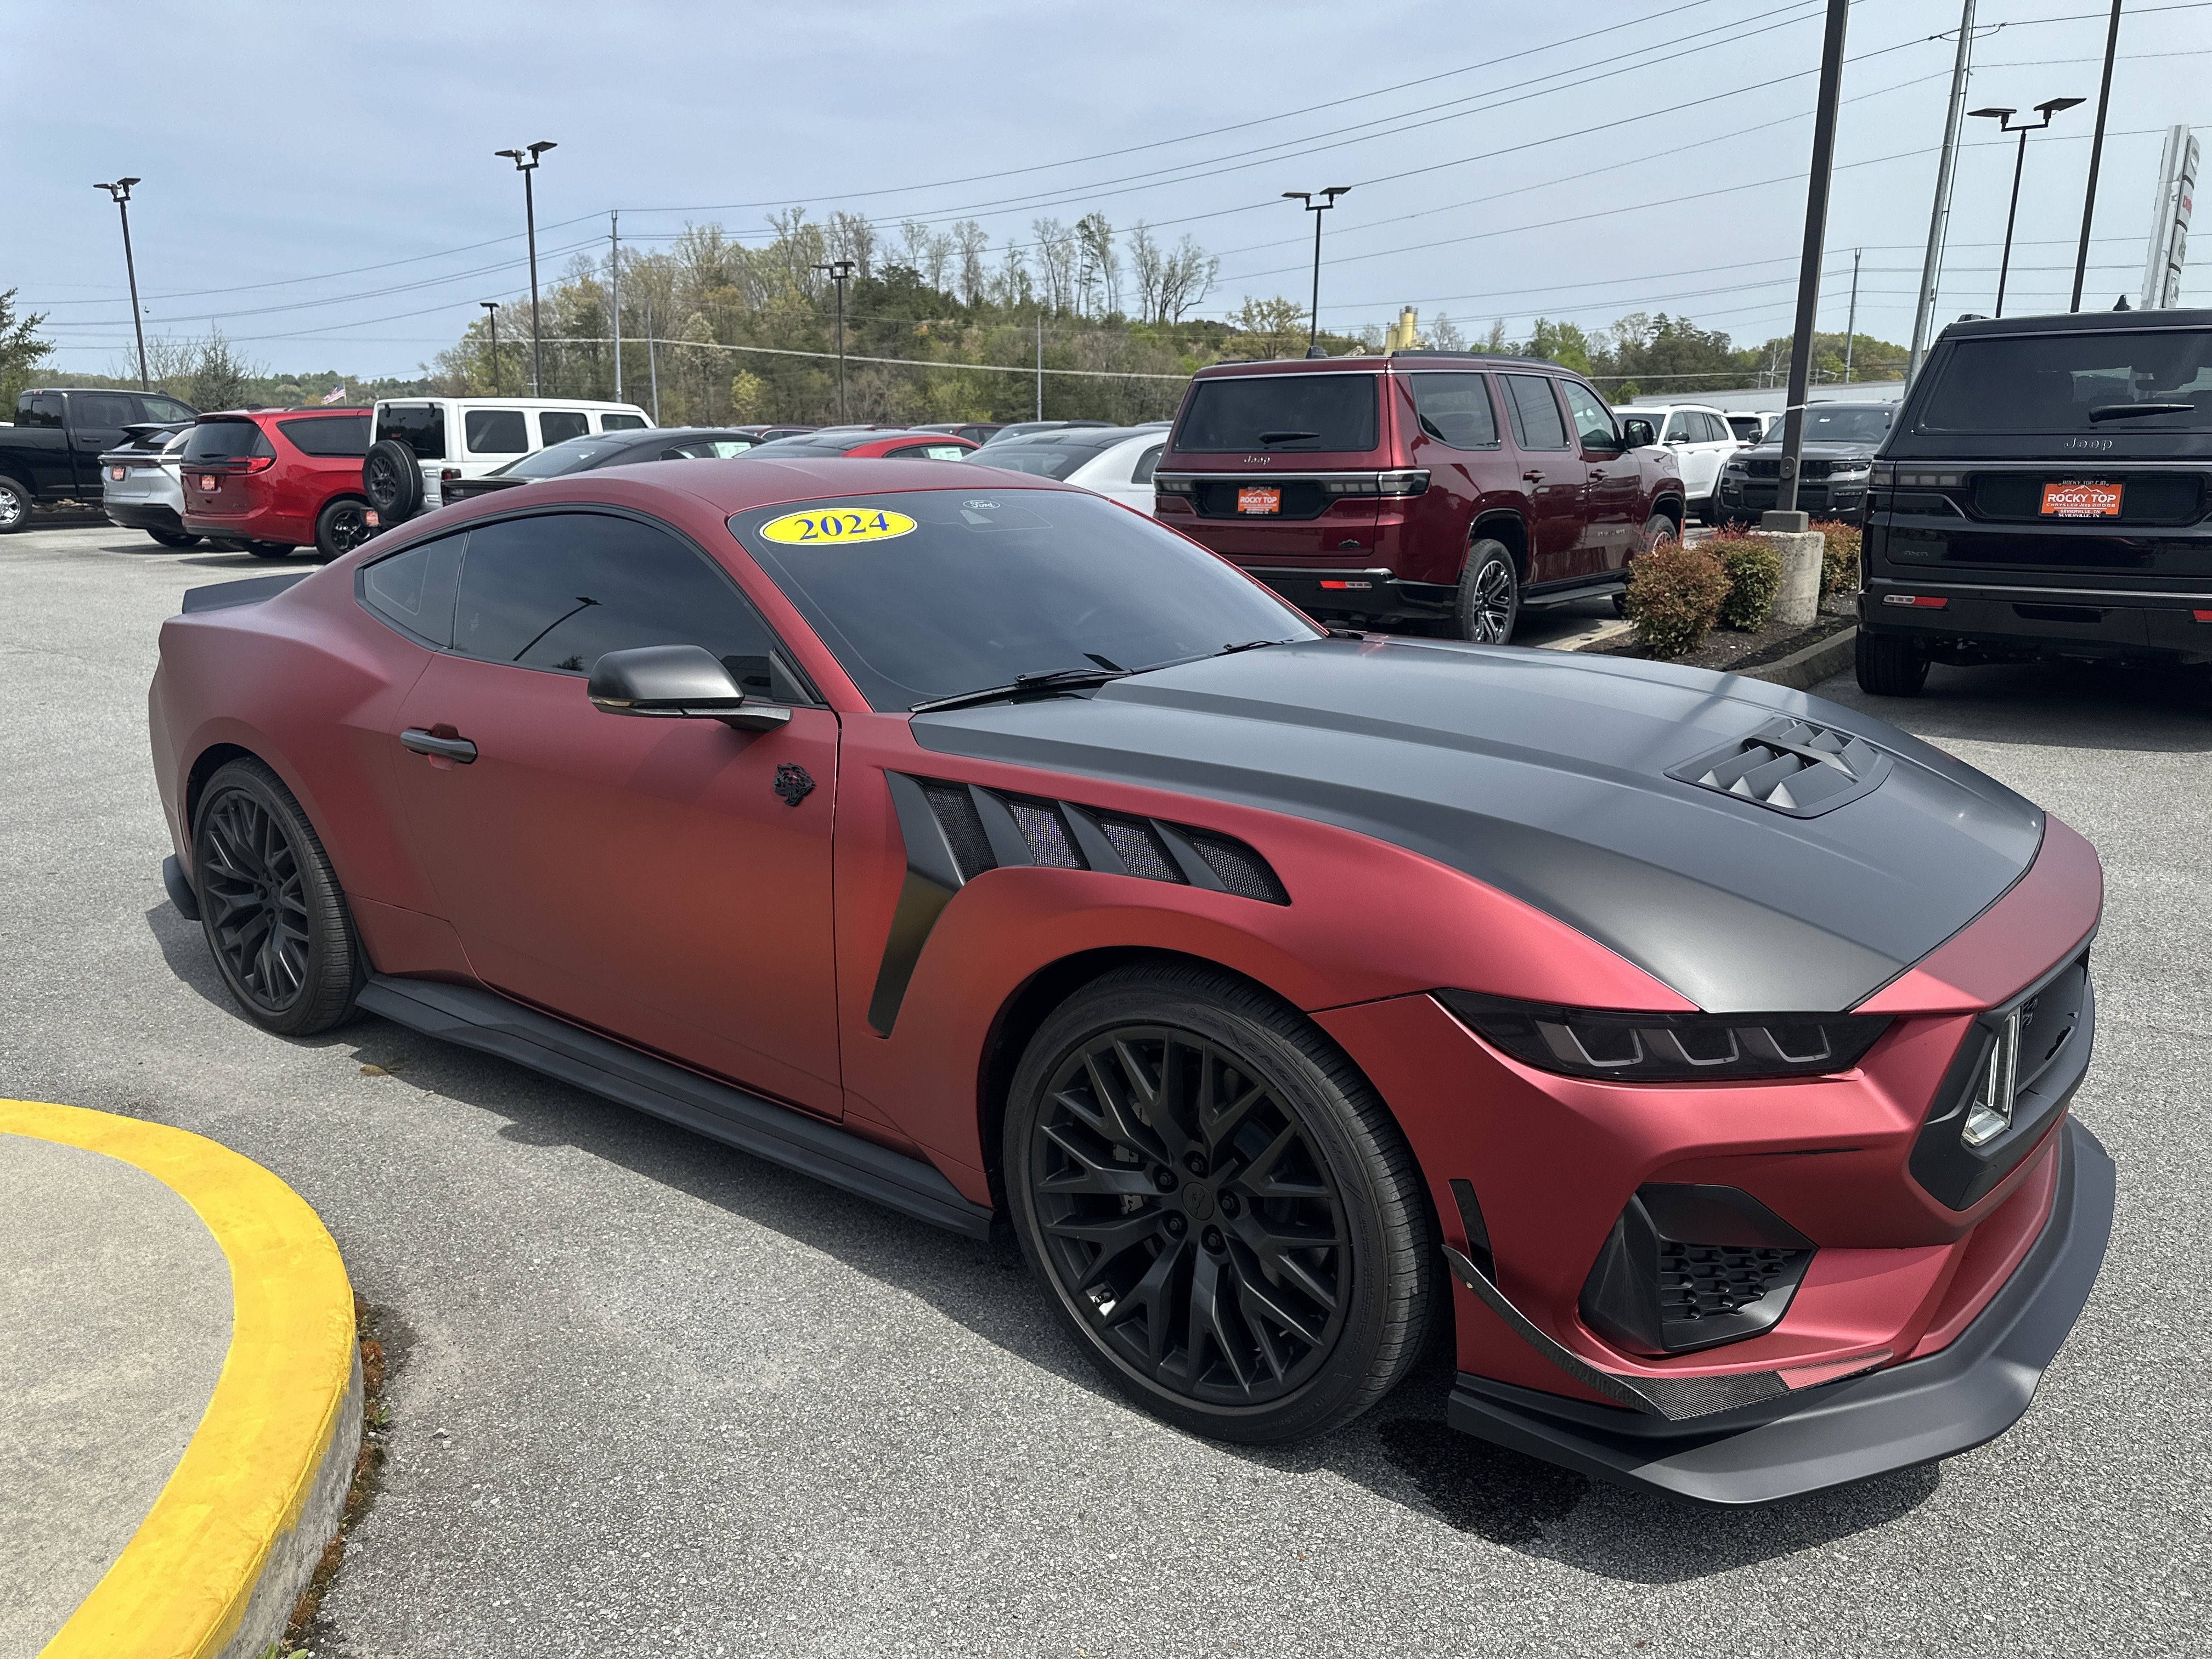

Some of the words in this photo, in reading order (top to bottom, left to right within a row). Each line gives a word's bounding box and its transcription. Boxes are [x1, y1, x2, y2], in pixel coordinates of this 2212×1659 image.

[2064, 438, 2112, 450] Jeep
[2047, 494, 2089, 503] ROCKY
[2091, 494, 2117, 503] TOP
[794, 513, 889, 540] 2024
[1243, 1041, 1319, 1117] EAGLE
